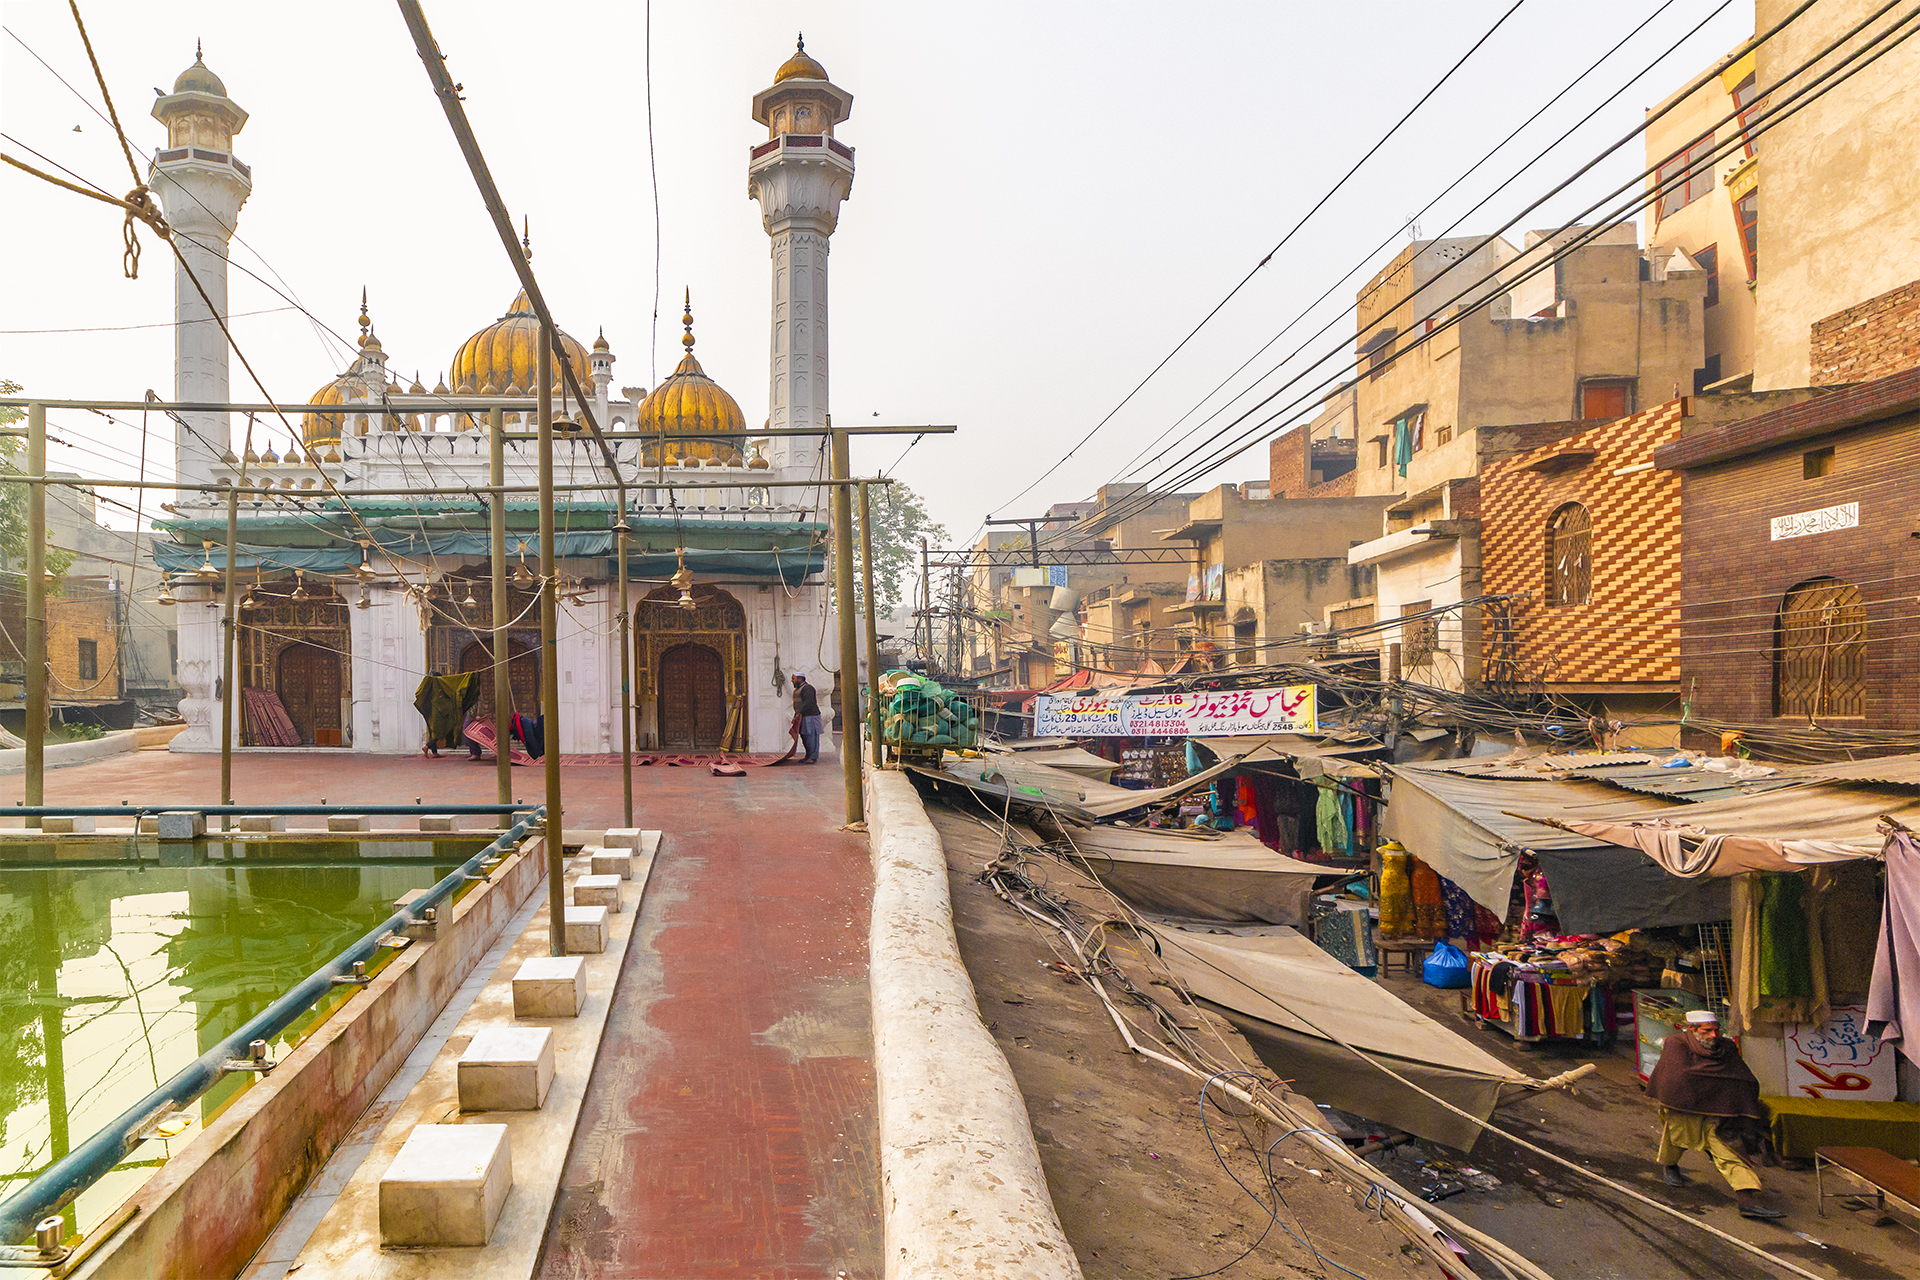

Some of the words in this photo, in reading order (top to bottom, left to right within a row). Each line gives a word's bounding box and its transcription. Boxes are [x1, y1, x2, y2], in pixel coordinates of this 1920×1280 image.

[1072, 697, 1109, 713] جیولری
[1184, 693, 1231, 719] جیولرز
[1226, 691, 1253, 718] محمود
[1249, 688, 1311, 718] عباس
[1065, 713, 1077, 722] 29
[1108, 713, 1118, 722] 16
[1272, 723, 1294, 731] 2548
